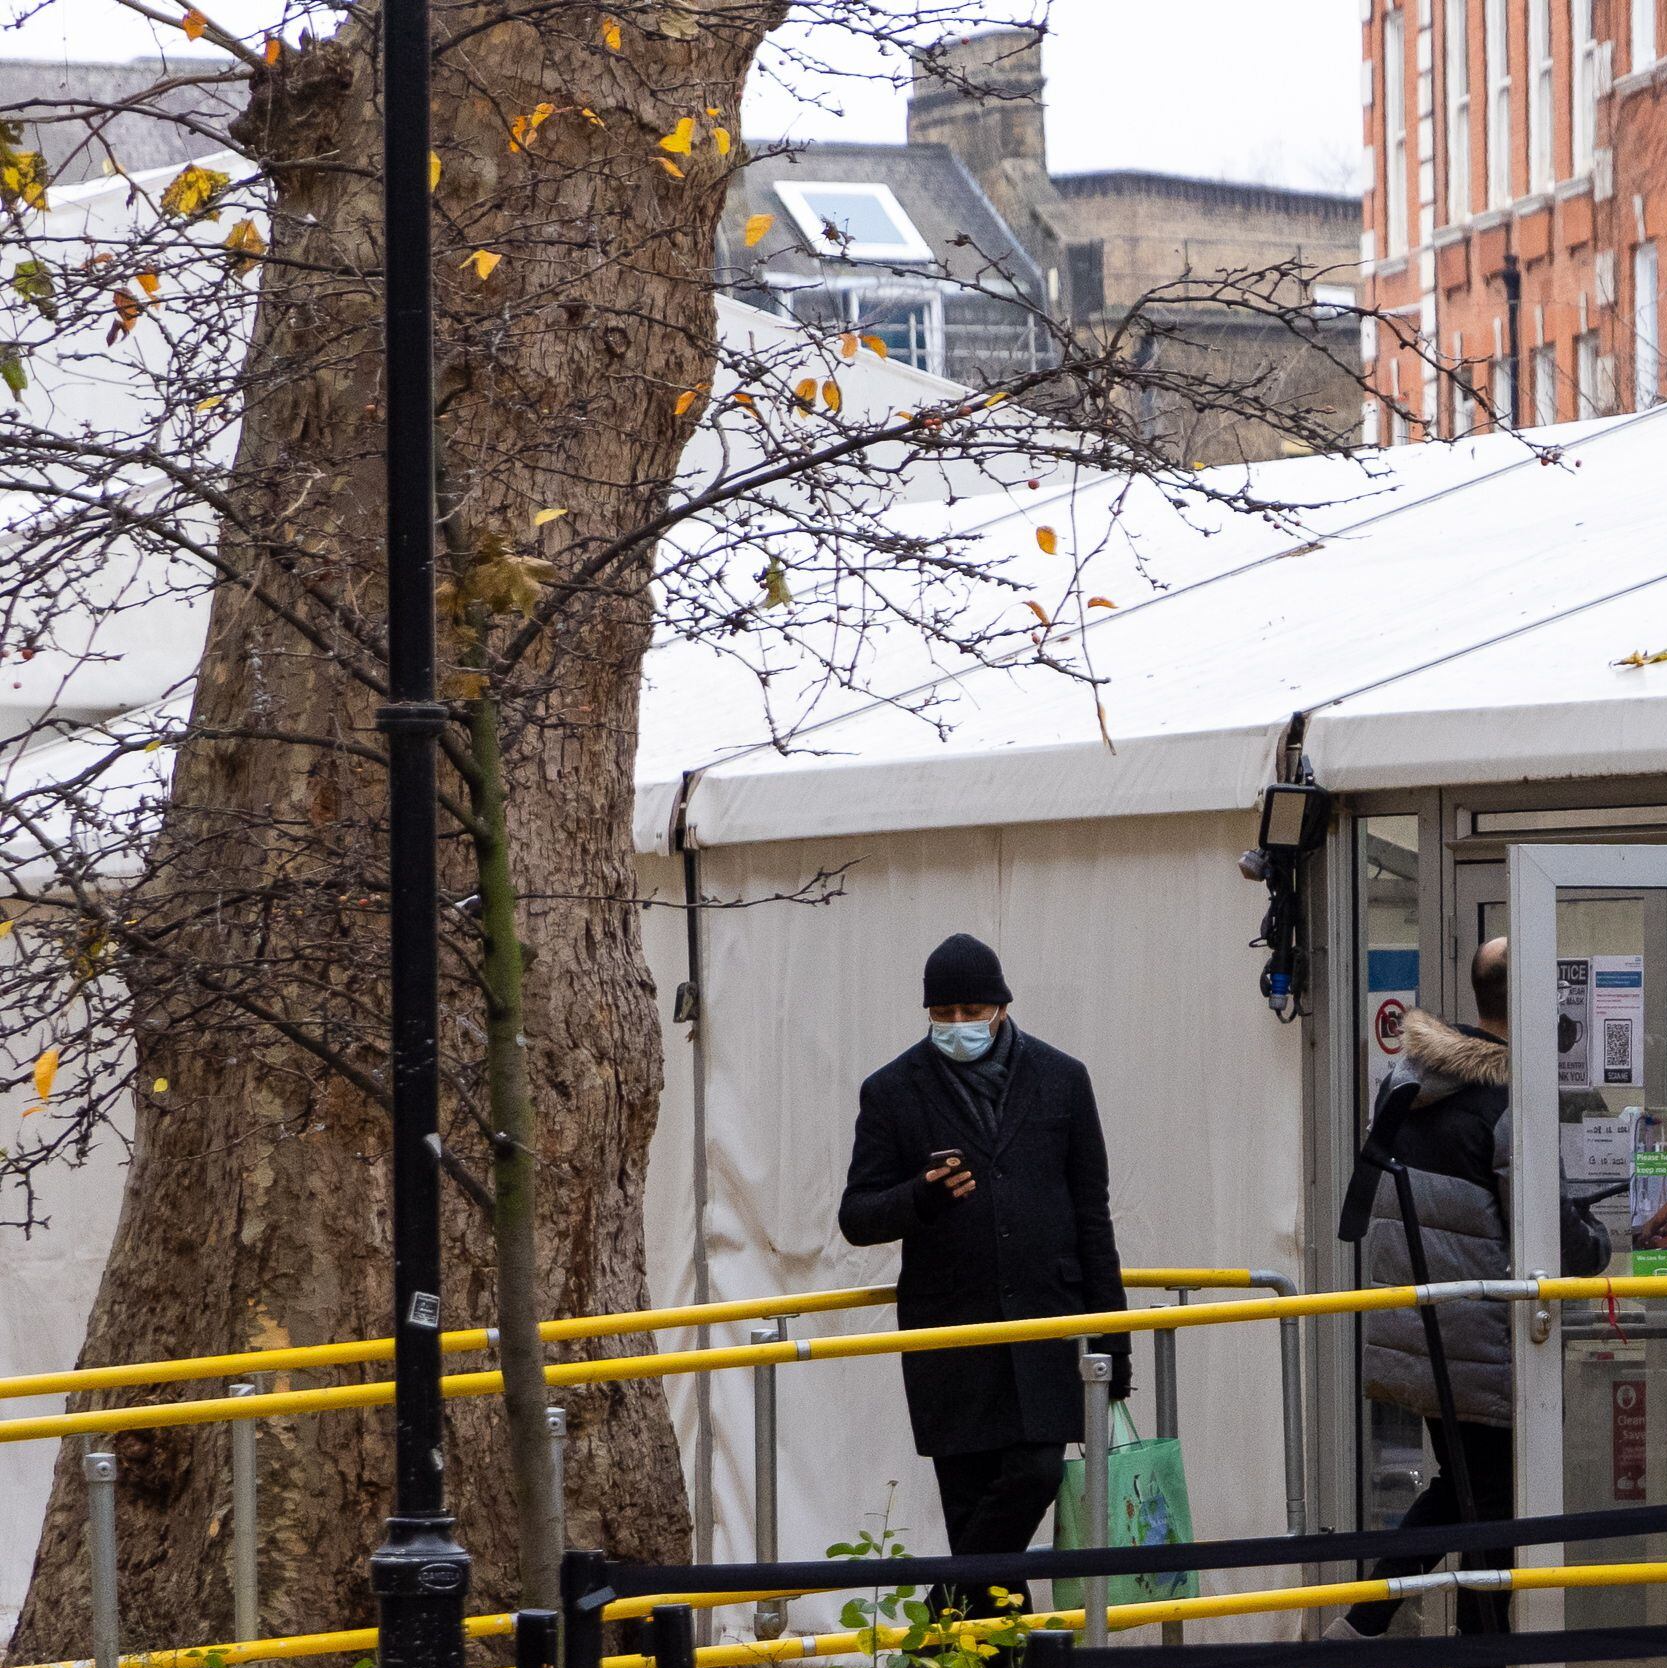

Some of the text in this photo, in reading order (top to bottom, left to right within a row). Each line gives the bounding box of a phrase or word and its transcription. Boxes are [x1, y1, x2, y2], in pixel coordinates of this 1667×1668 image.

[1557, 964, 1587, 980] TICE
[1571, 1072, 1586, 1081] YOU
[1636, 1165, 1654, 1174] keep
